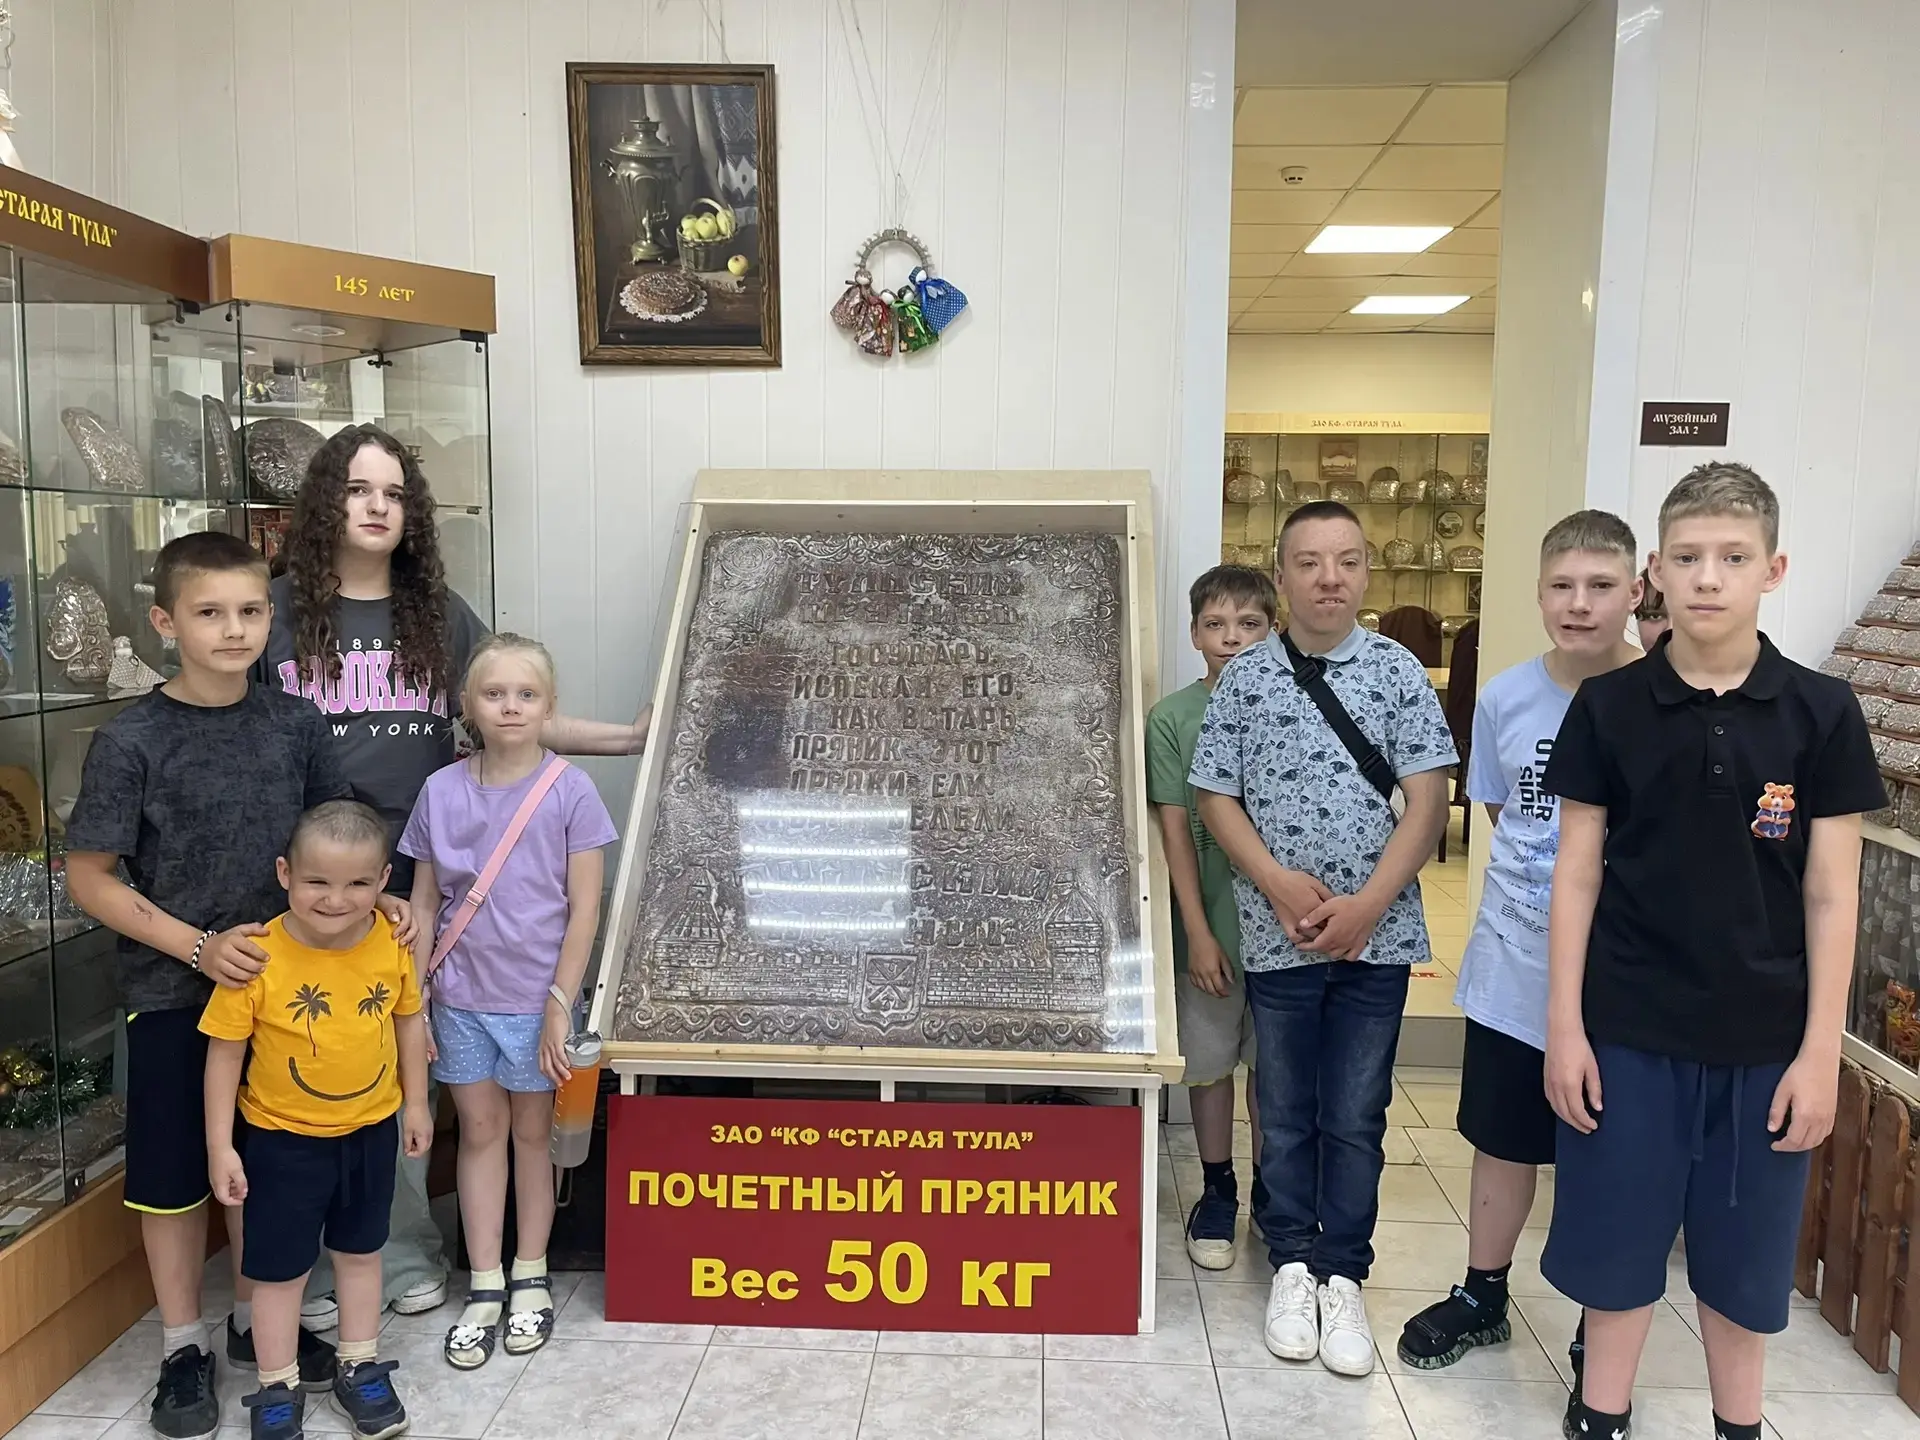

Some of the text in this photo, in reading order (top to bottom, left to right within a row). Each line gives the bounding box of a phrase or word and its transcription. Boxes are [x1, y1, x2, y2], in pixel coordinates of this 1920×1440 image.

[334, 274, 368, 296] 145
[1669, 425, 1699, 435] ЗАЛ 2
[368, 723, 435, 736] YORK
[829, 706, 886, 730] КАК
[791, 734, 1002, 764] ПРЯНИК ЭТОТ
[1518, 765, 1536, 817] SIDE
[710, 1124, 763, 1144] ЗАО
[628, 1170, 1118, 1216] ПОЧЕТНЫЙ ПРЯНИК
[691, 1257, 800, 1301] Вес
[824, 1239, 928, 1305] 50
